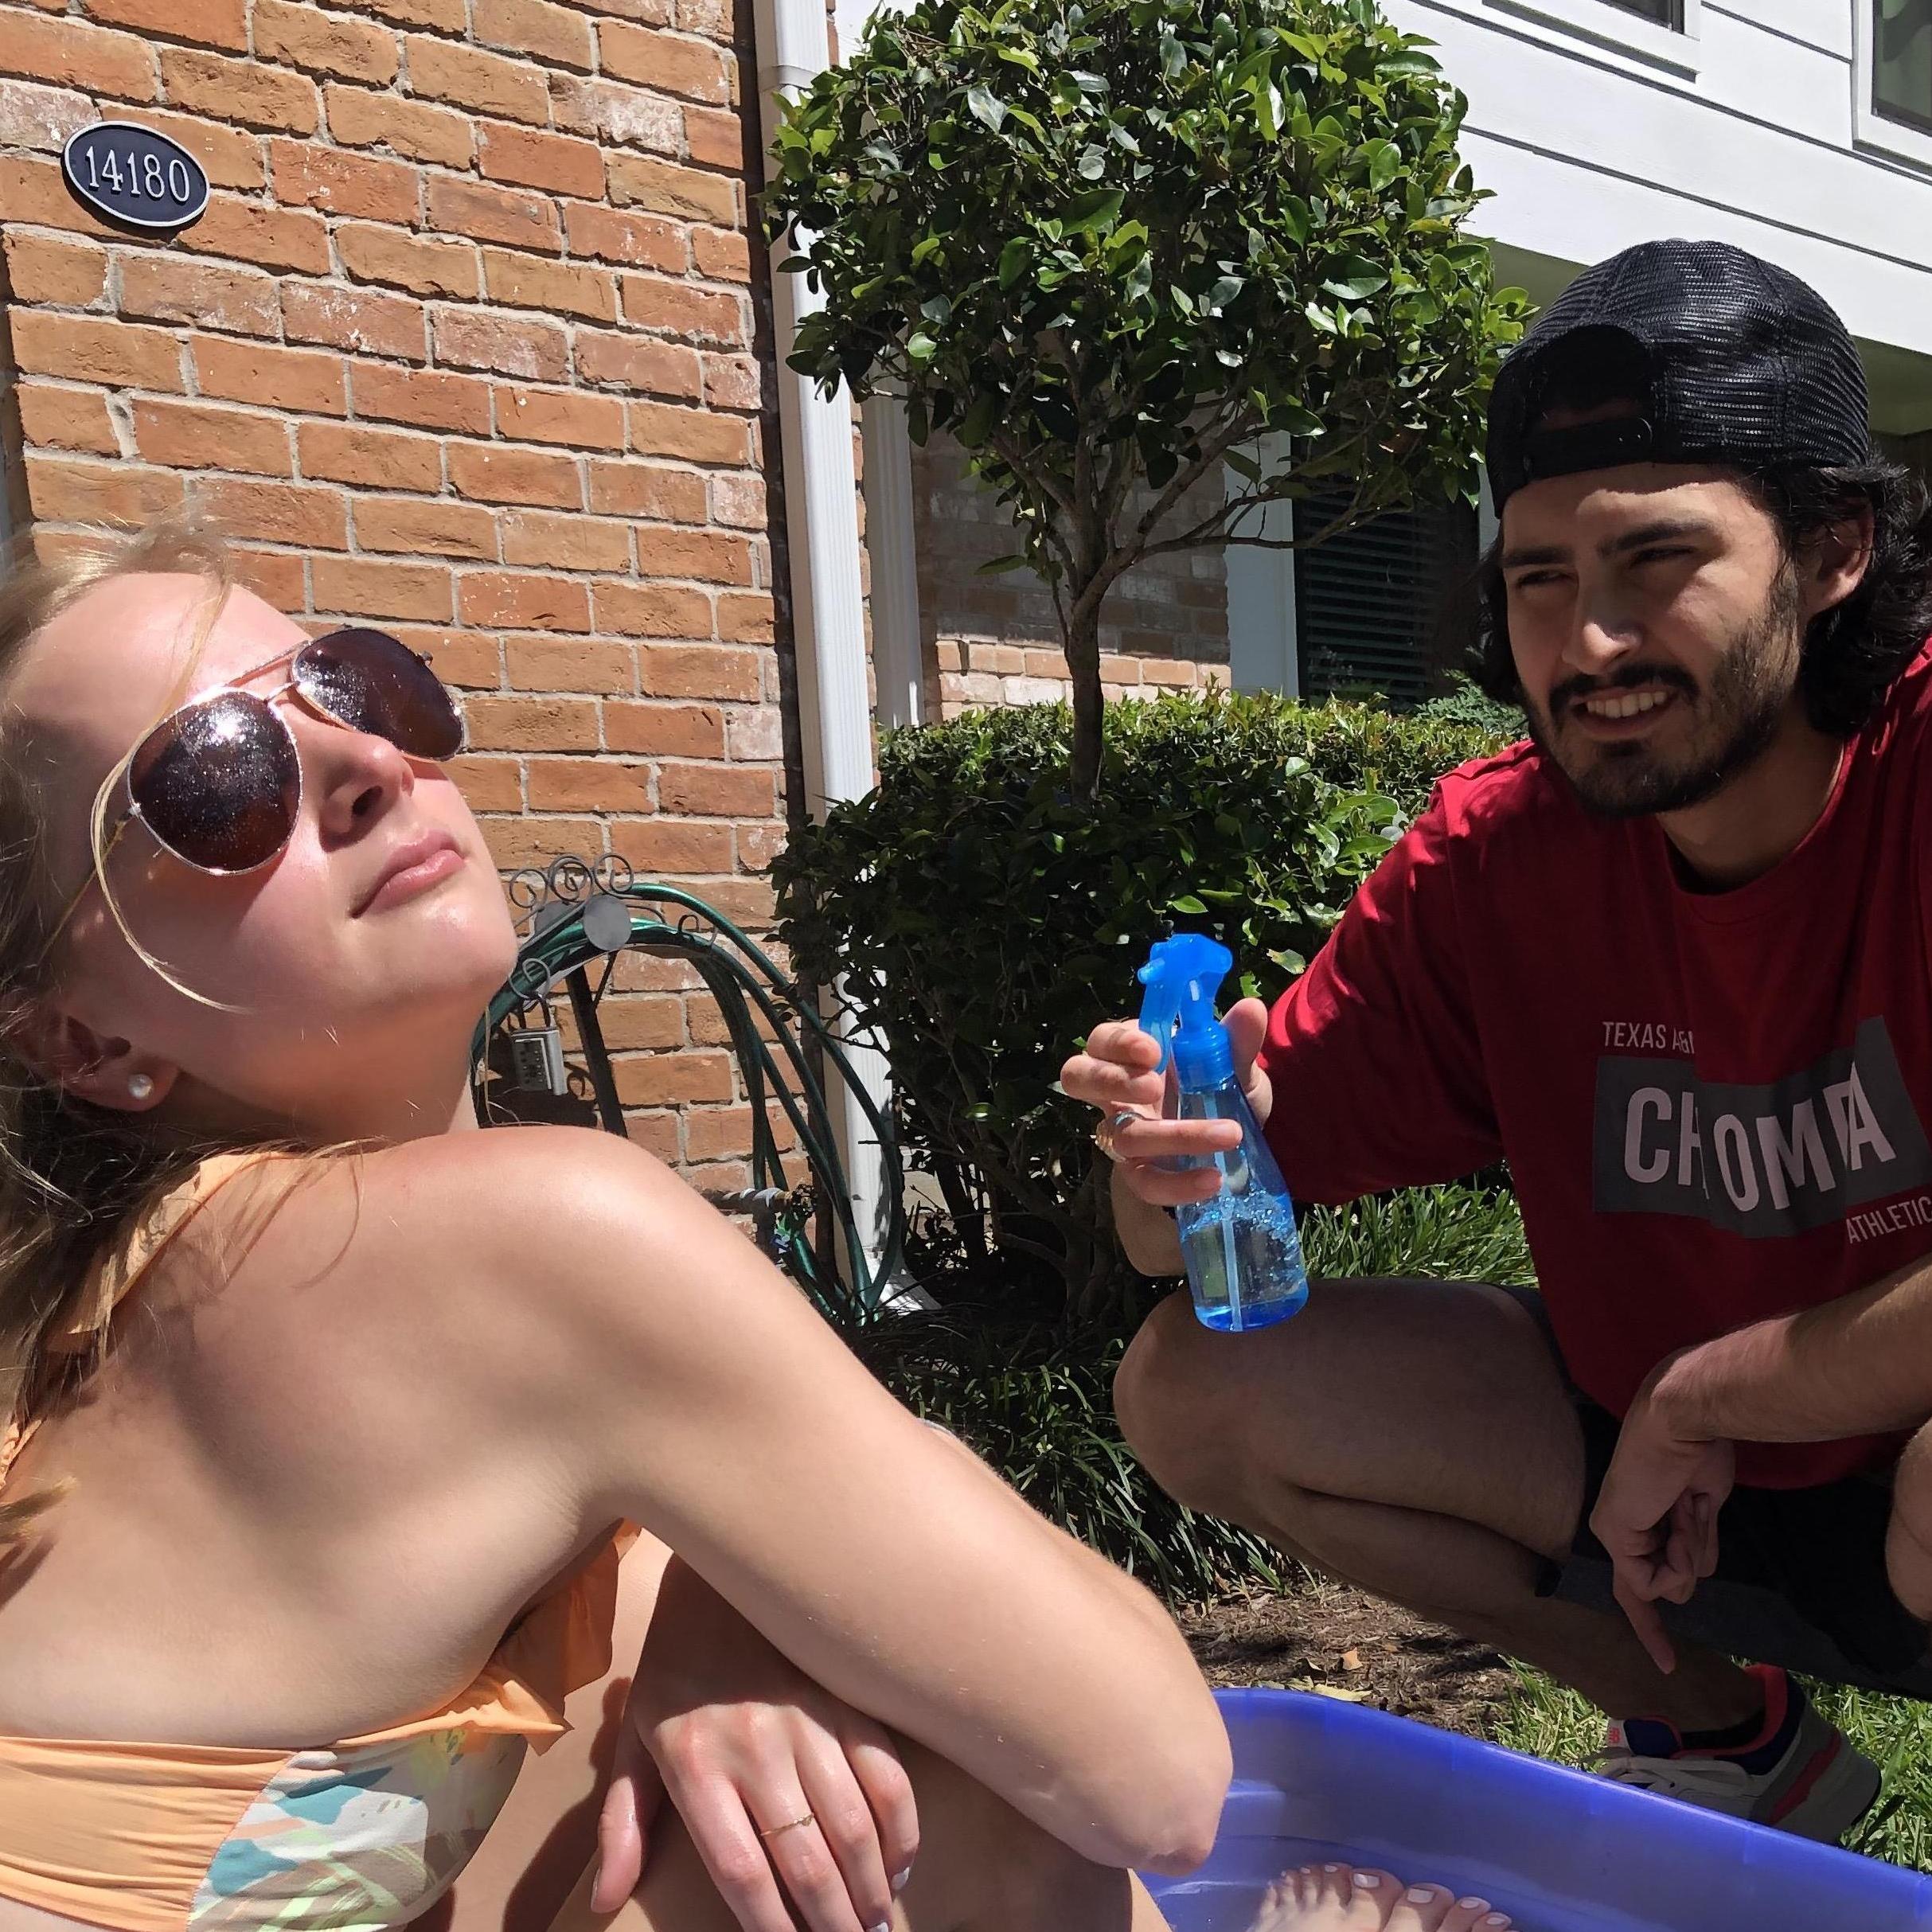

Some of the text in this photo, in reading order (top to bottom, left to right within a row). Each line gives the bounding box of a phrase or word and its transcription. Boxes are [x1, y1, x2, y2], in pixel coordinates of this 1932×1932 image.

[85, 146, 190, 202] 14180
[1602, 1021, 1667, 1049] TEXAS
[1845, 1196, 1932, 1244] ATHLETIC
